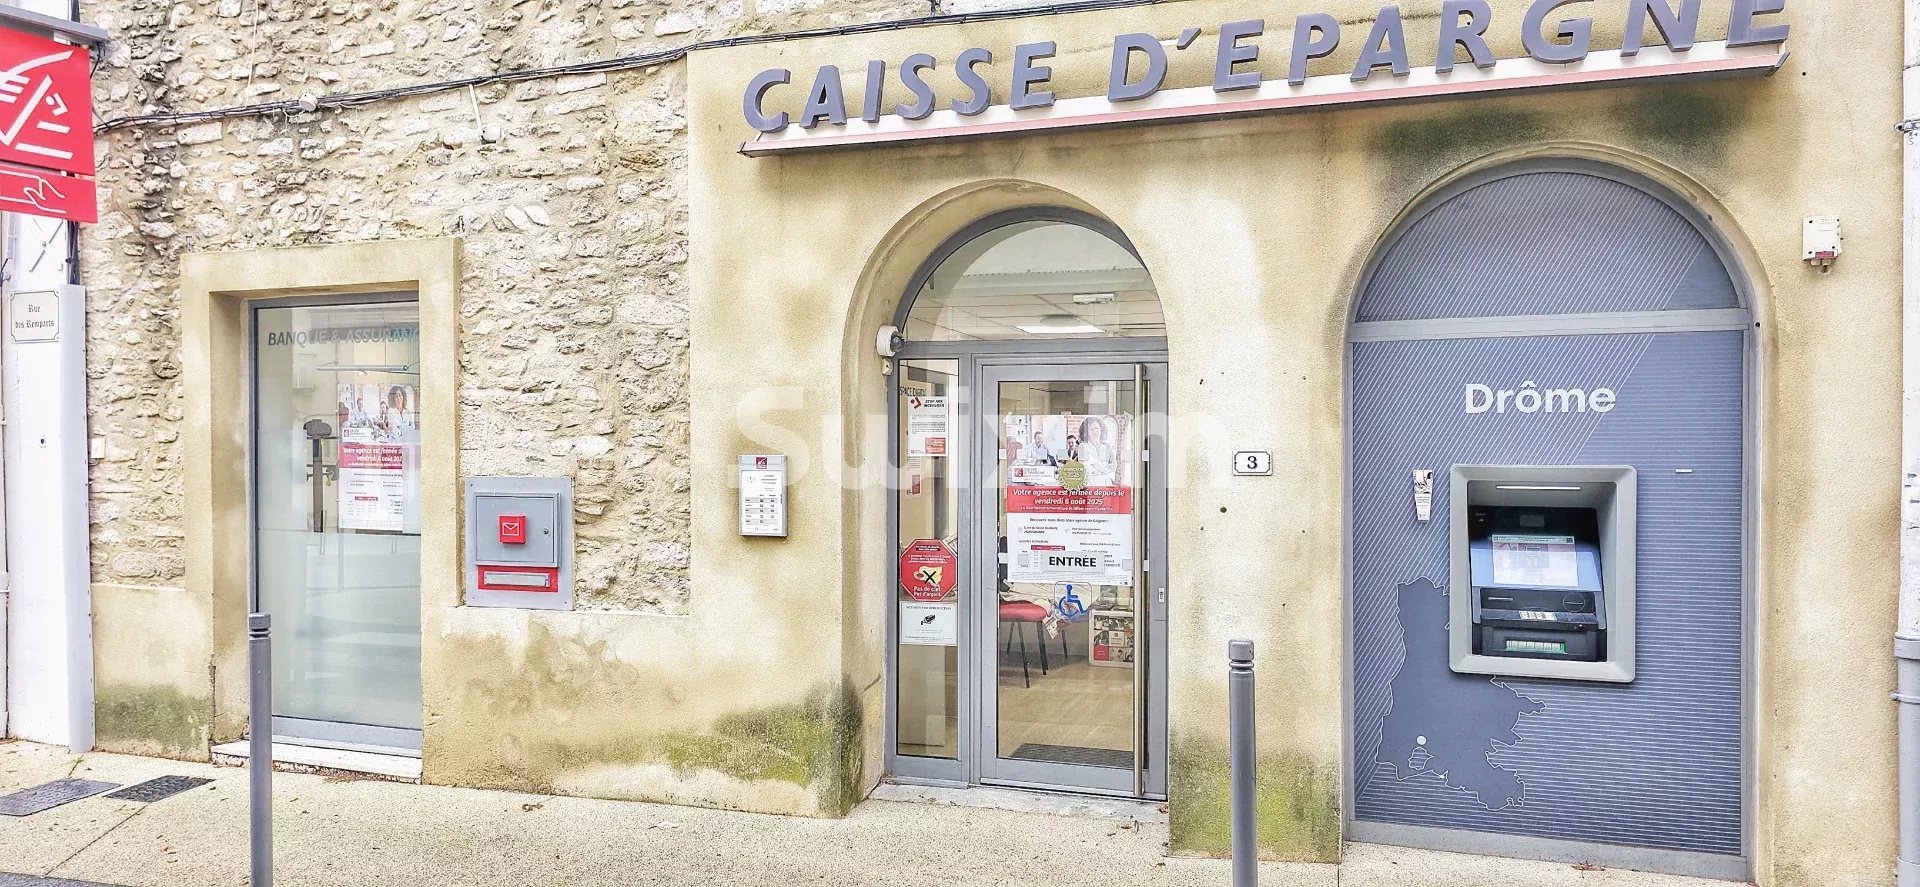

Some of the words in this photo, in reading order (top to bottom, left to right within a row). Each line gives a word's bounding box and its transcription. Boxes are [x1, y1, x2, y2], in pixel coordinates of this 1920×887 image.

[742, 41, 1057, 134] CAISSE
[28, 304, 41, 313] Rue
[15, 320, 25, 329] des
[26, 319, 55, 329] Remparts
[267, 330, 328, 348] BANQUE
[331, 328, 340, 342] &
[1465, 380, 1616, 414] Drôme
[1247, 455, 1258, 470] 3
[1068, 490, 1092, 498] fermée
[1093, 489, 1117, 498] depuis
[1034, 497, 1064, 505] vendredi
[1048, 554, 1097, 568] ENTRÉE
